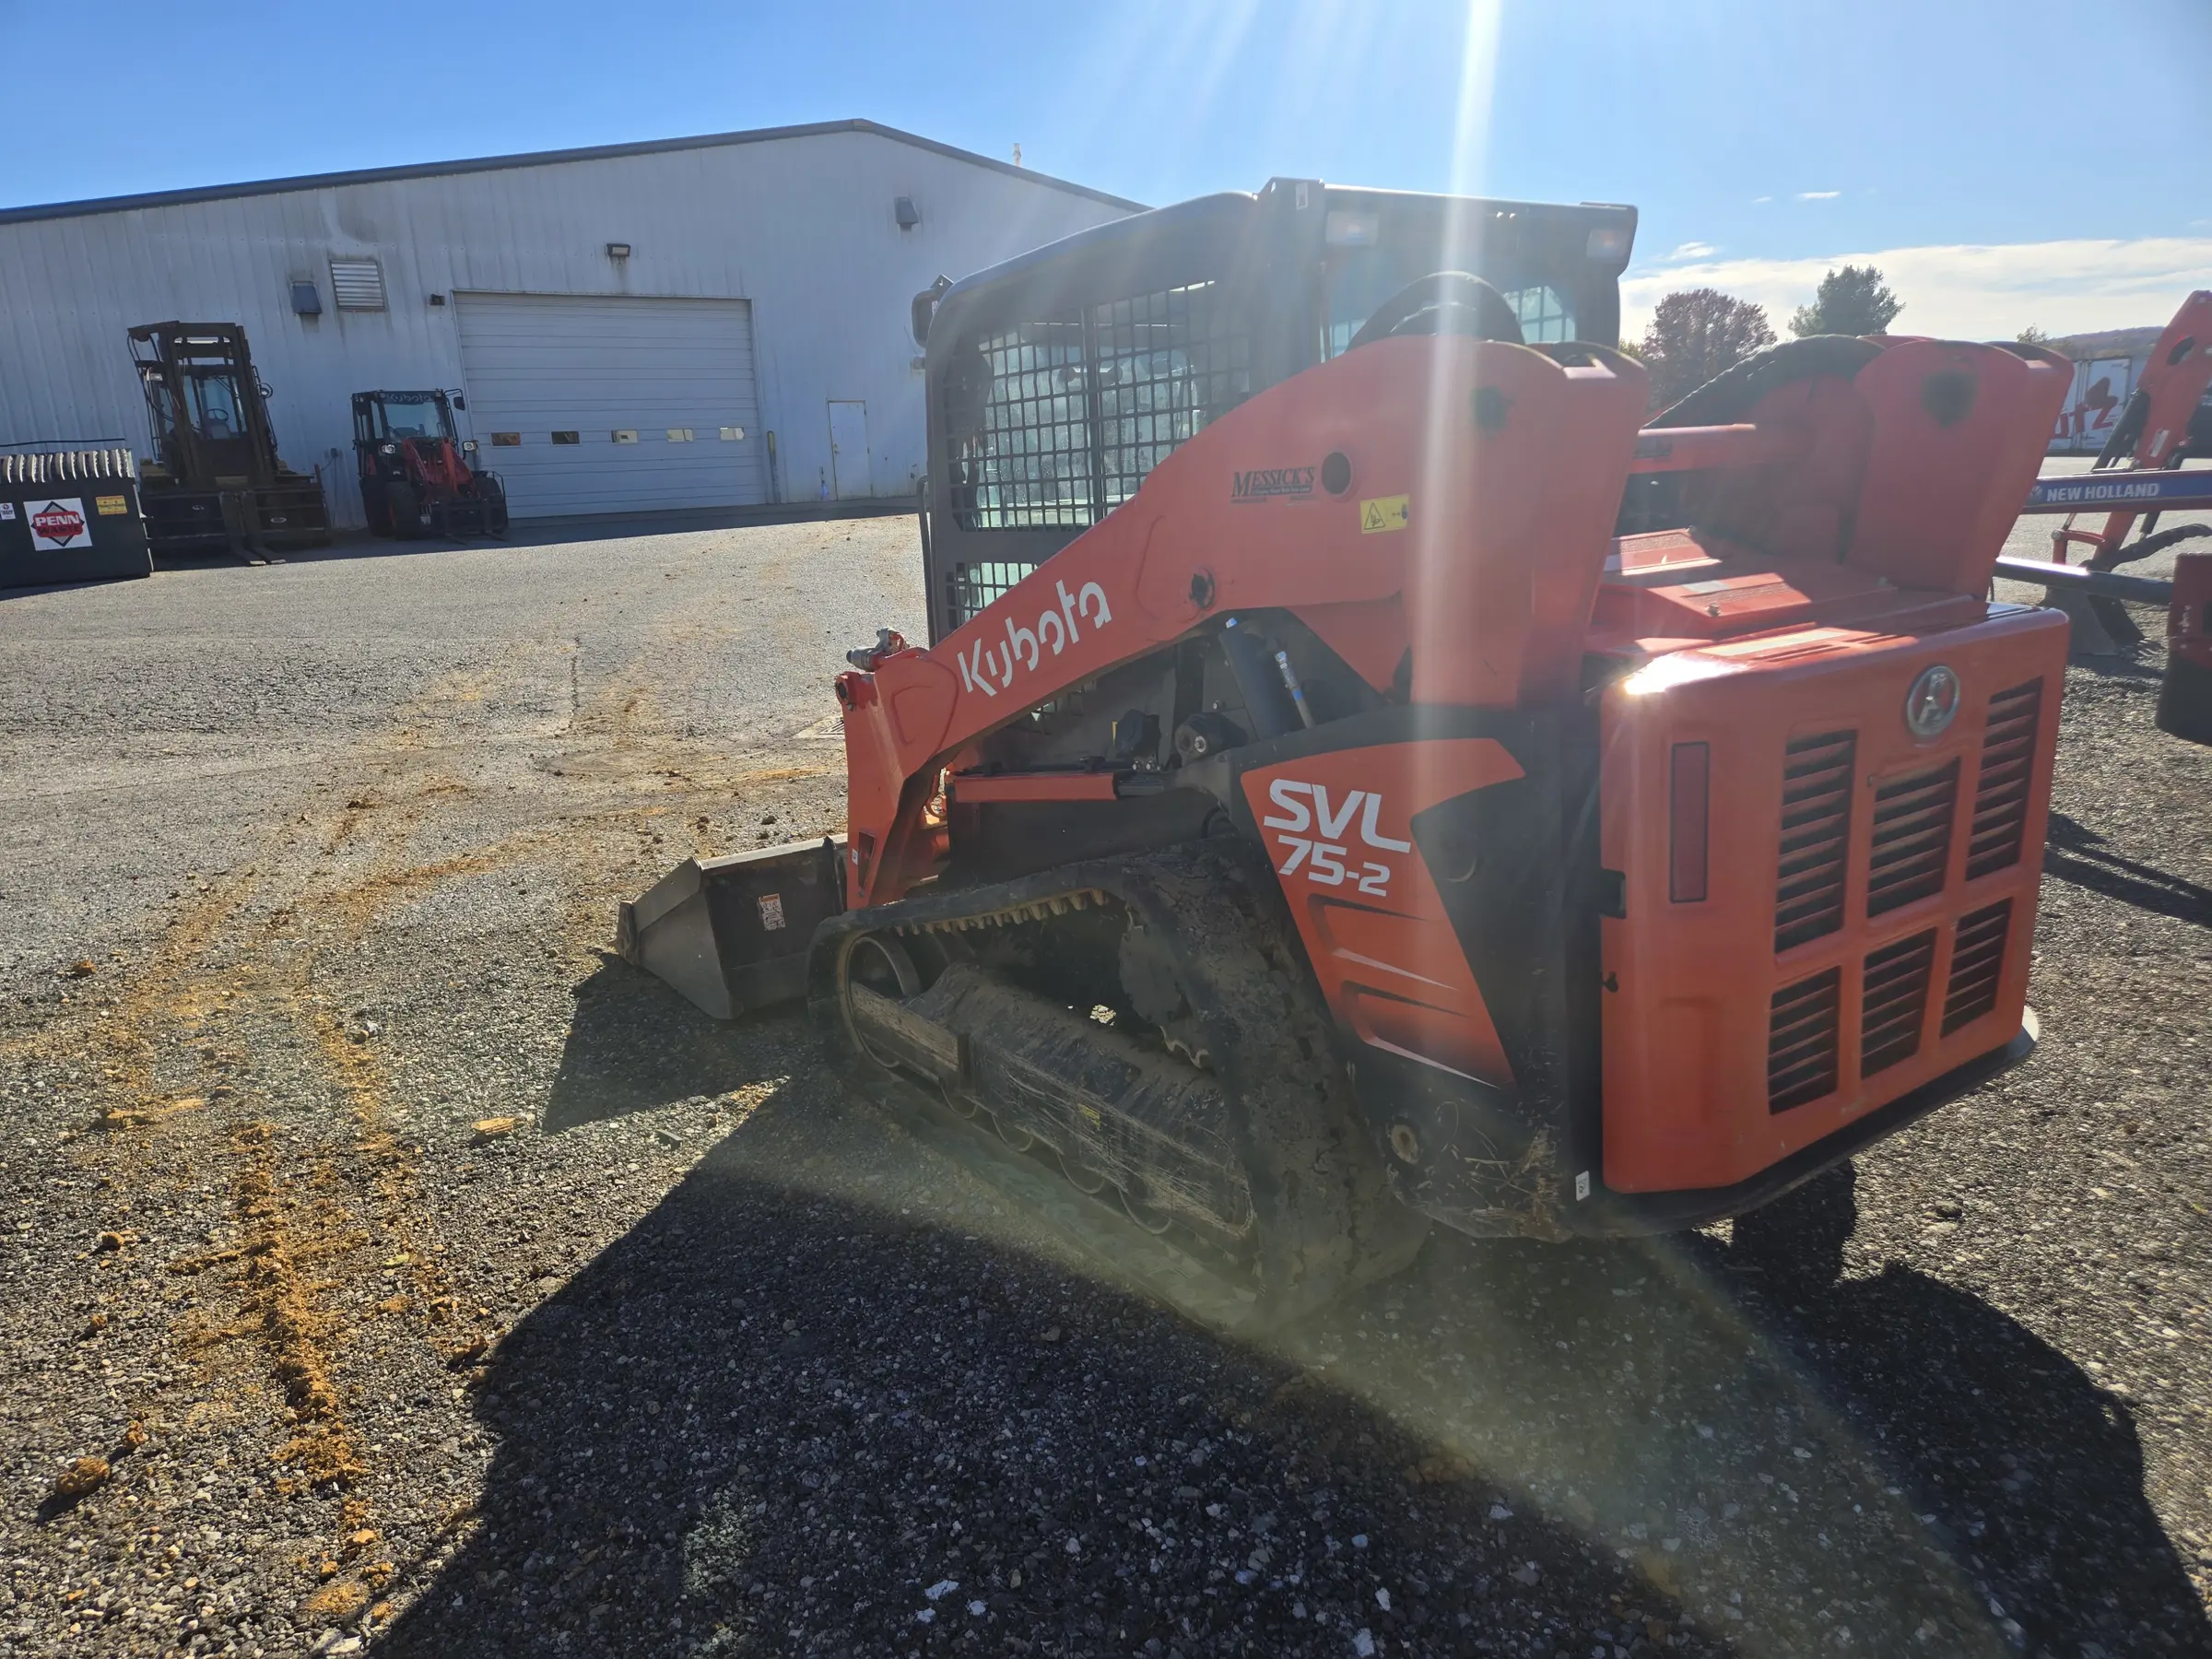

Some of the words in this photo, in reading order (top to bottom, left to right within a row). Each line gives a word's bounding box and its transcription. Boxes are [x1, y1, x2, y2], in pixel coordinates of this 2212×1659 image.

[386, 393, 432, 403] Kubota
[2046, 488, 2084, 502] NEW
[2085, 483, 2160, 500] HOLLAND
[35, 514, 80, 526] PENN
[38, 525, 83, 535] WASTE
[957, 580, 1112, 697] Kubota
[1264, 778, 1411, 853] SVL
[1278, 834, 1391, 897] 75-2
